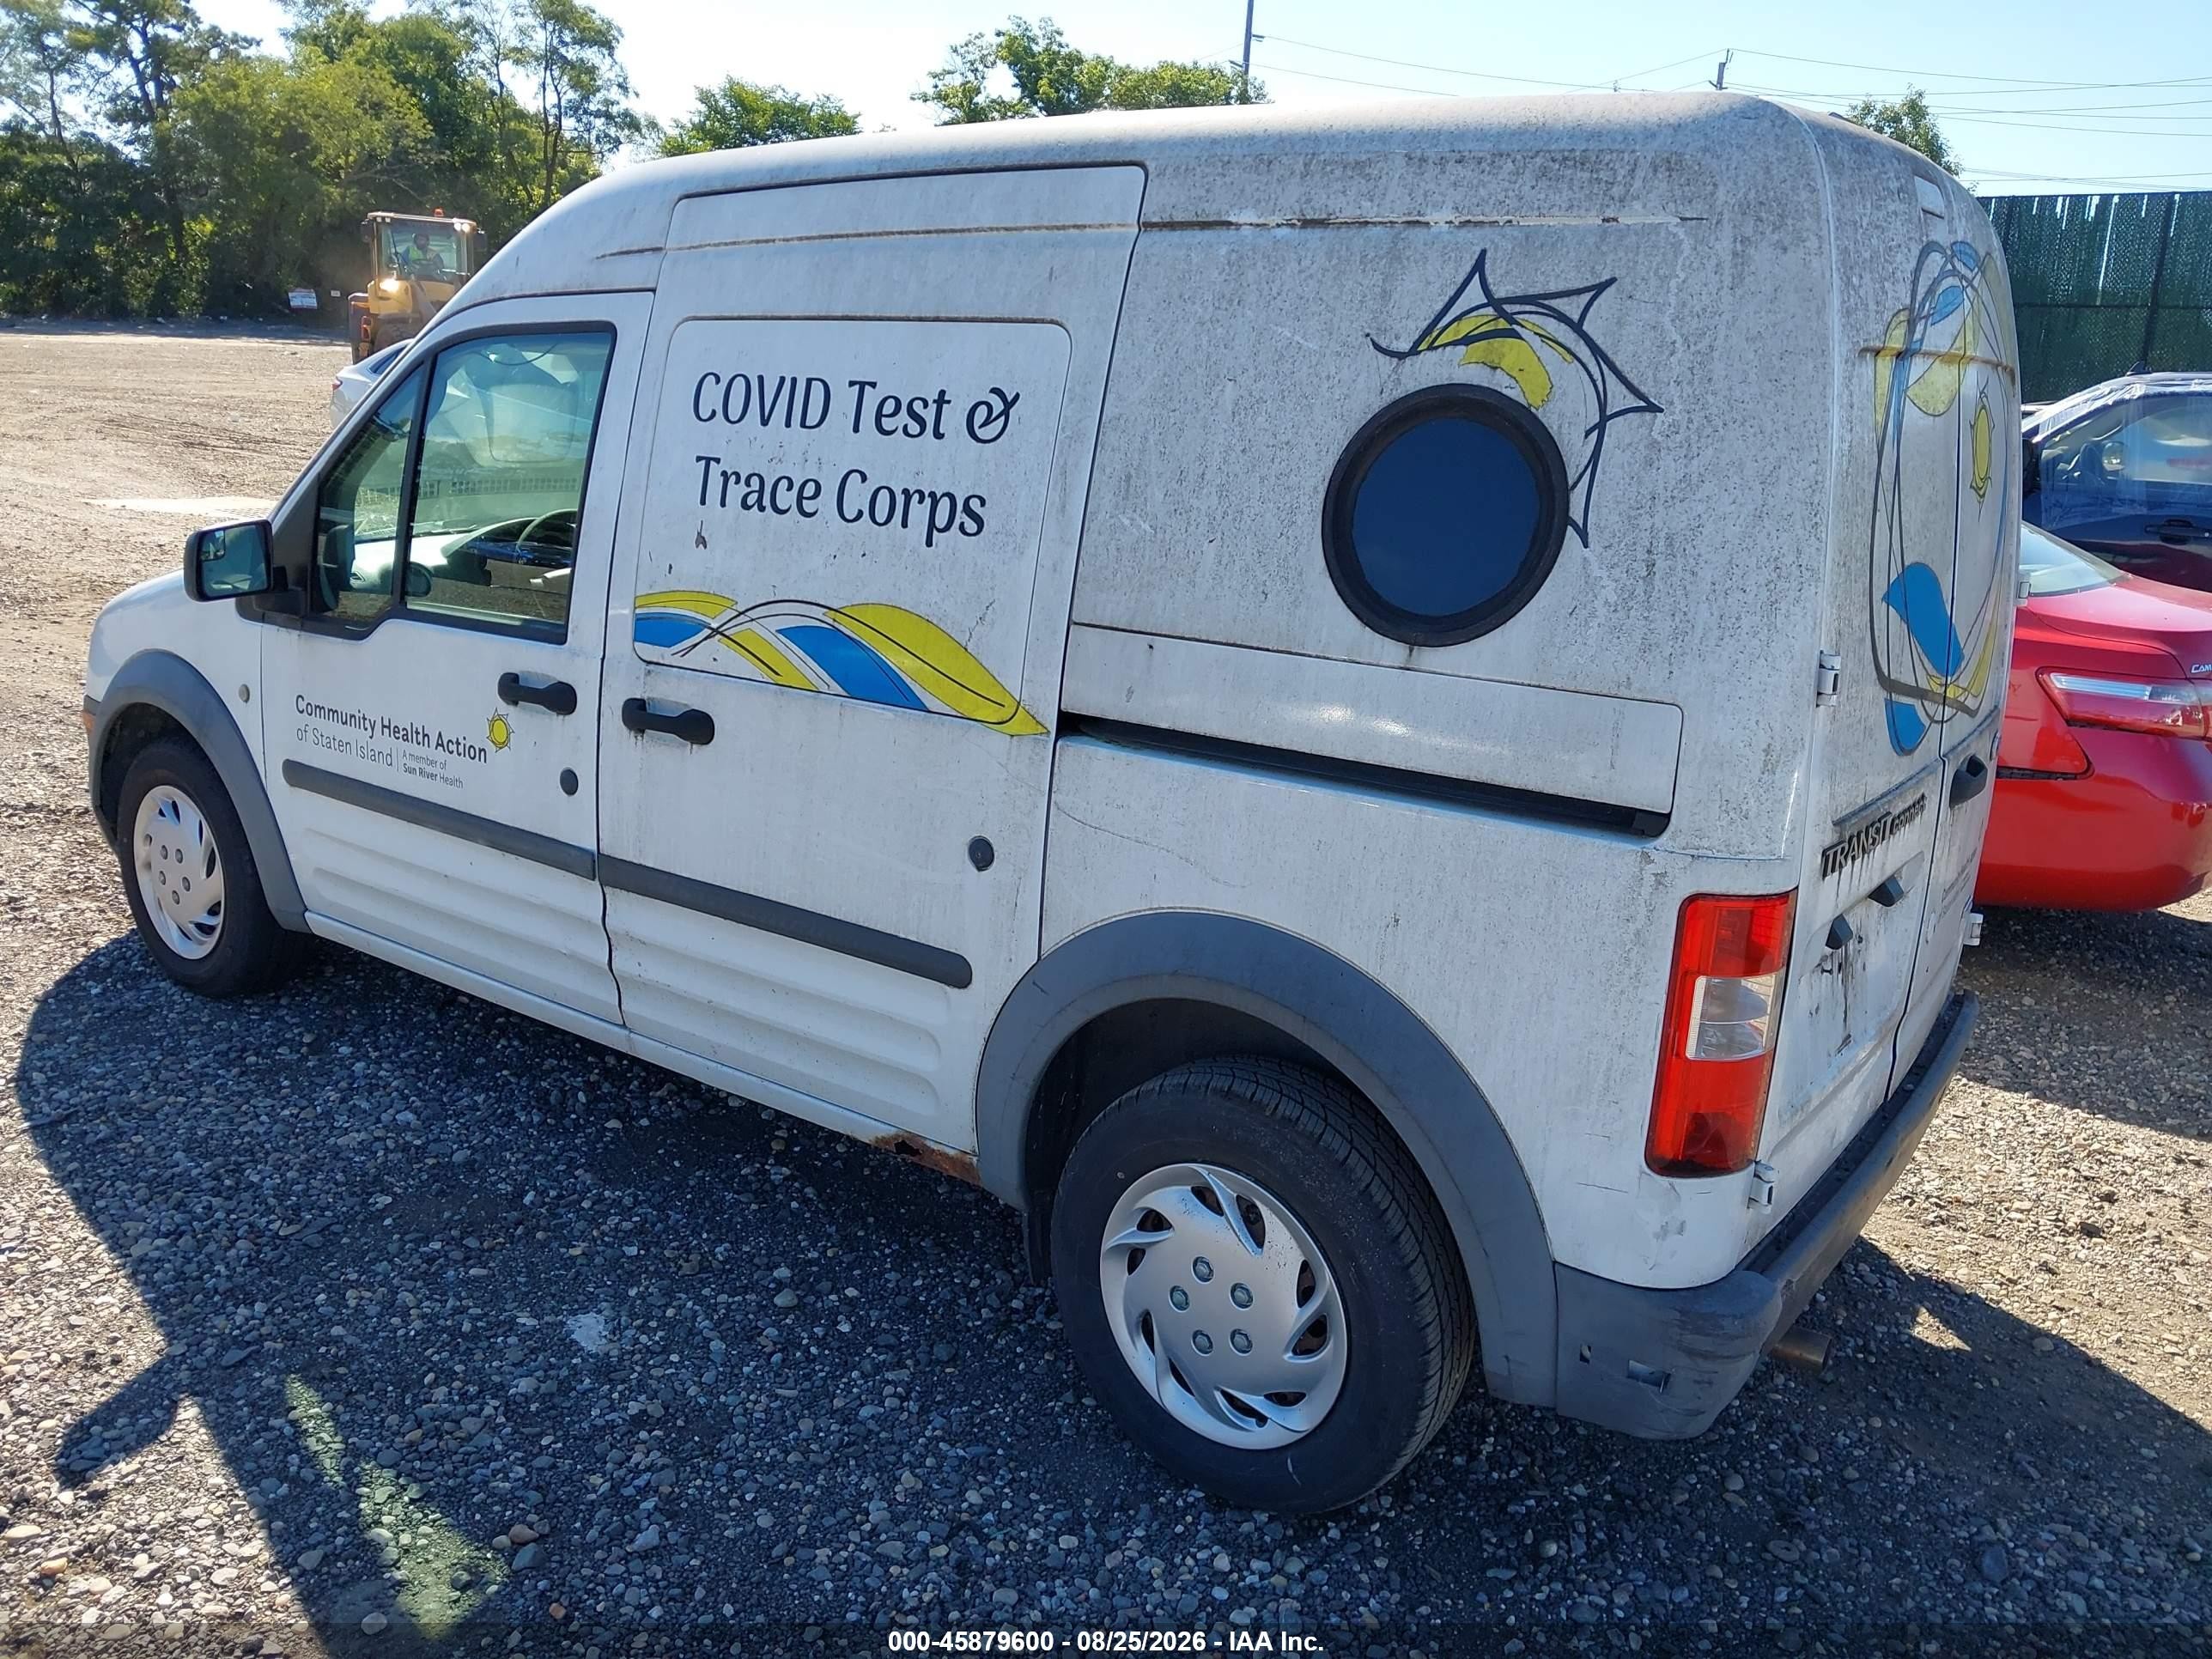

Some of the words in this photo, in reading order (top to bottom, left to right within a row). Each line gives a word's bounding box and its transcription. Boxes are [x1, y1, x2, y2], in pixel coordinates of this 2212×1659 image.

[693, 372, 831, 429] COVID
[848, 380, 951, 440] Test
[966, 386, 1020, 444] &
[695, 455, 823, 518] Trace
[836, 469, 987, 547] Corps
[295, 694, 377, 739] Community
[380, 715, 430, 749] Health
[434, 731, 488, 763] Action
[296, 724, 309, 743] of
[312, 727, 352, 756] Staten
[356, 738, 393, 768] Island
[402, 749, 408, 761] A
[408, 752, 437, 769] member
[439, 759, 447, 770] of
[403, 763, 417, 776] Sun
[418, 767, 438, 781] River
[439, 773, 464, 788] Health
[1821, 811, 1894, 879] TRANSIT
